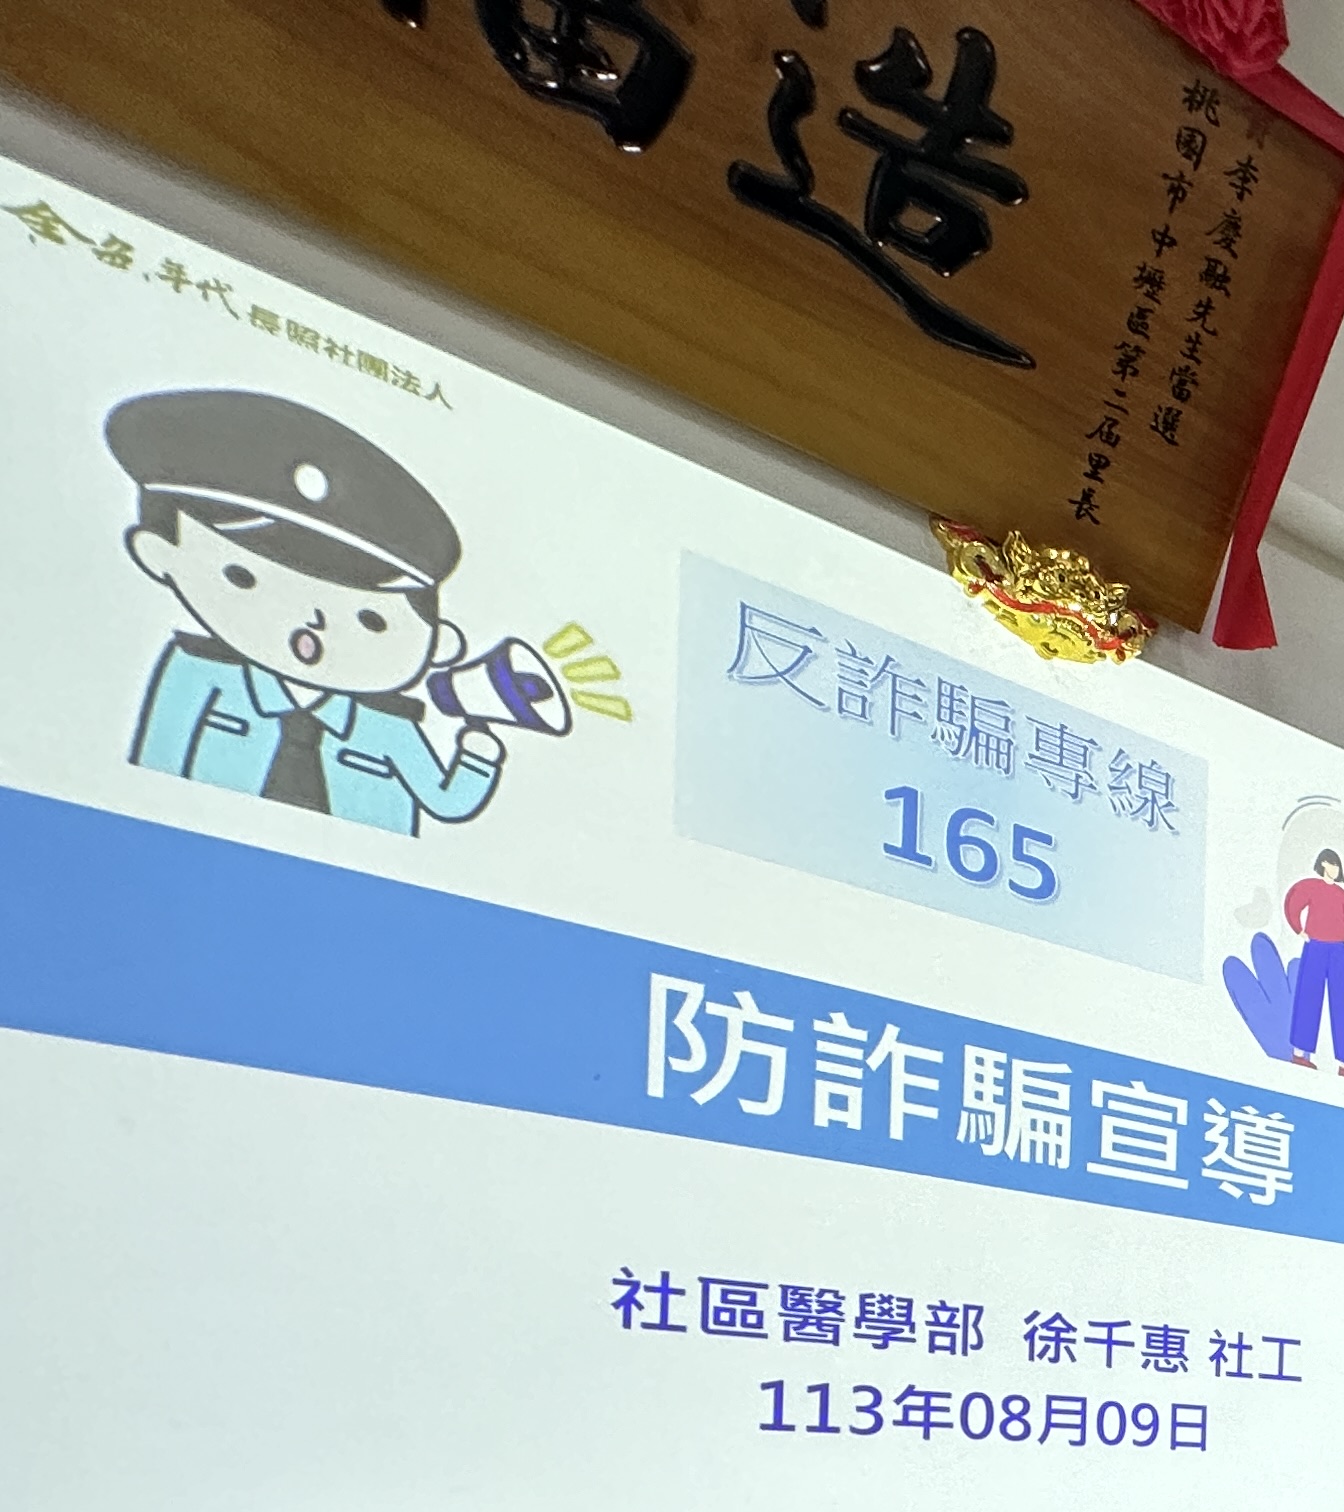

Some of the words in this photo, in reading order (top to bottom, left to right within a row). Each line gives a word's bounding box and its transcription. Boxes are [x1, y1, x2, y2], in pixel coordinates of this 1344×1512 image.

[727, 601, 1180, 834] 反詐騙專線
[883, 784, 1060, 902] 165
[645, 971, 1296, 1207] 防詐騙宣導
[611, 1266, 986, 1358] 社區醫學部
[1023, 1308, 1192, 1375] 徐千惠
[1209, 1329, 1305, 1383] 社工
[759, 1379, 1210, 1453] 113年08月09日
